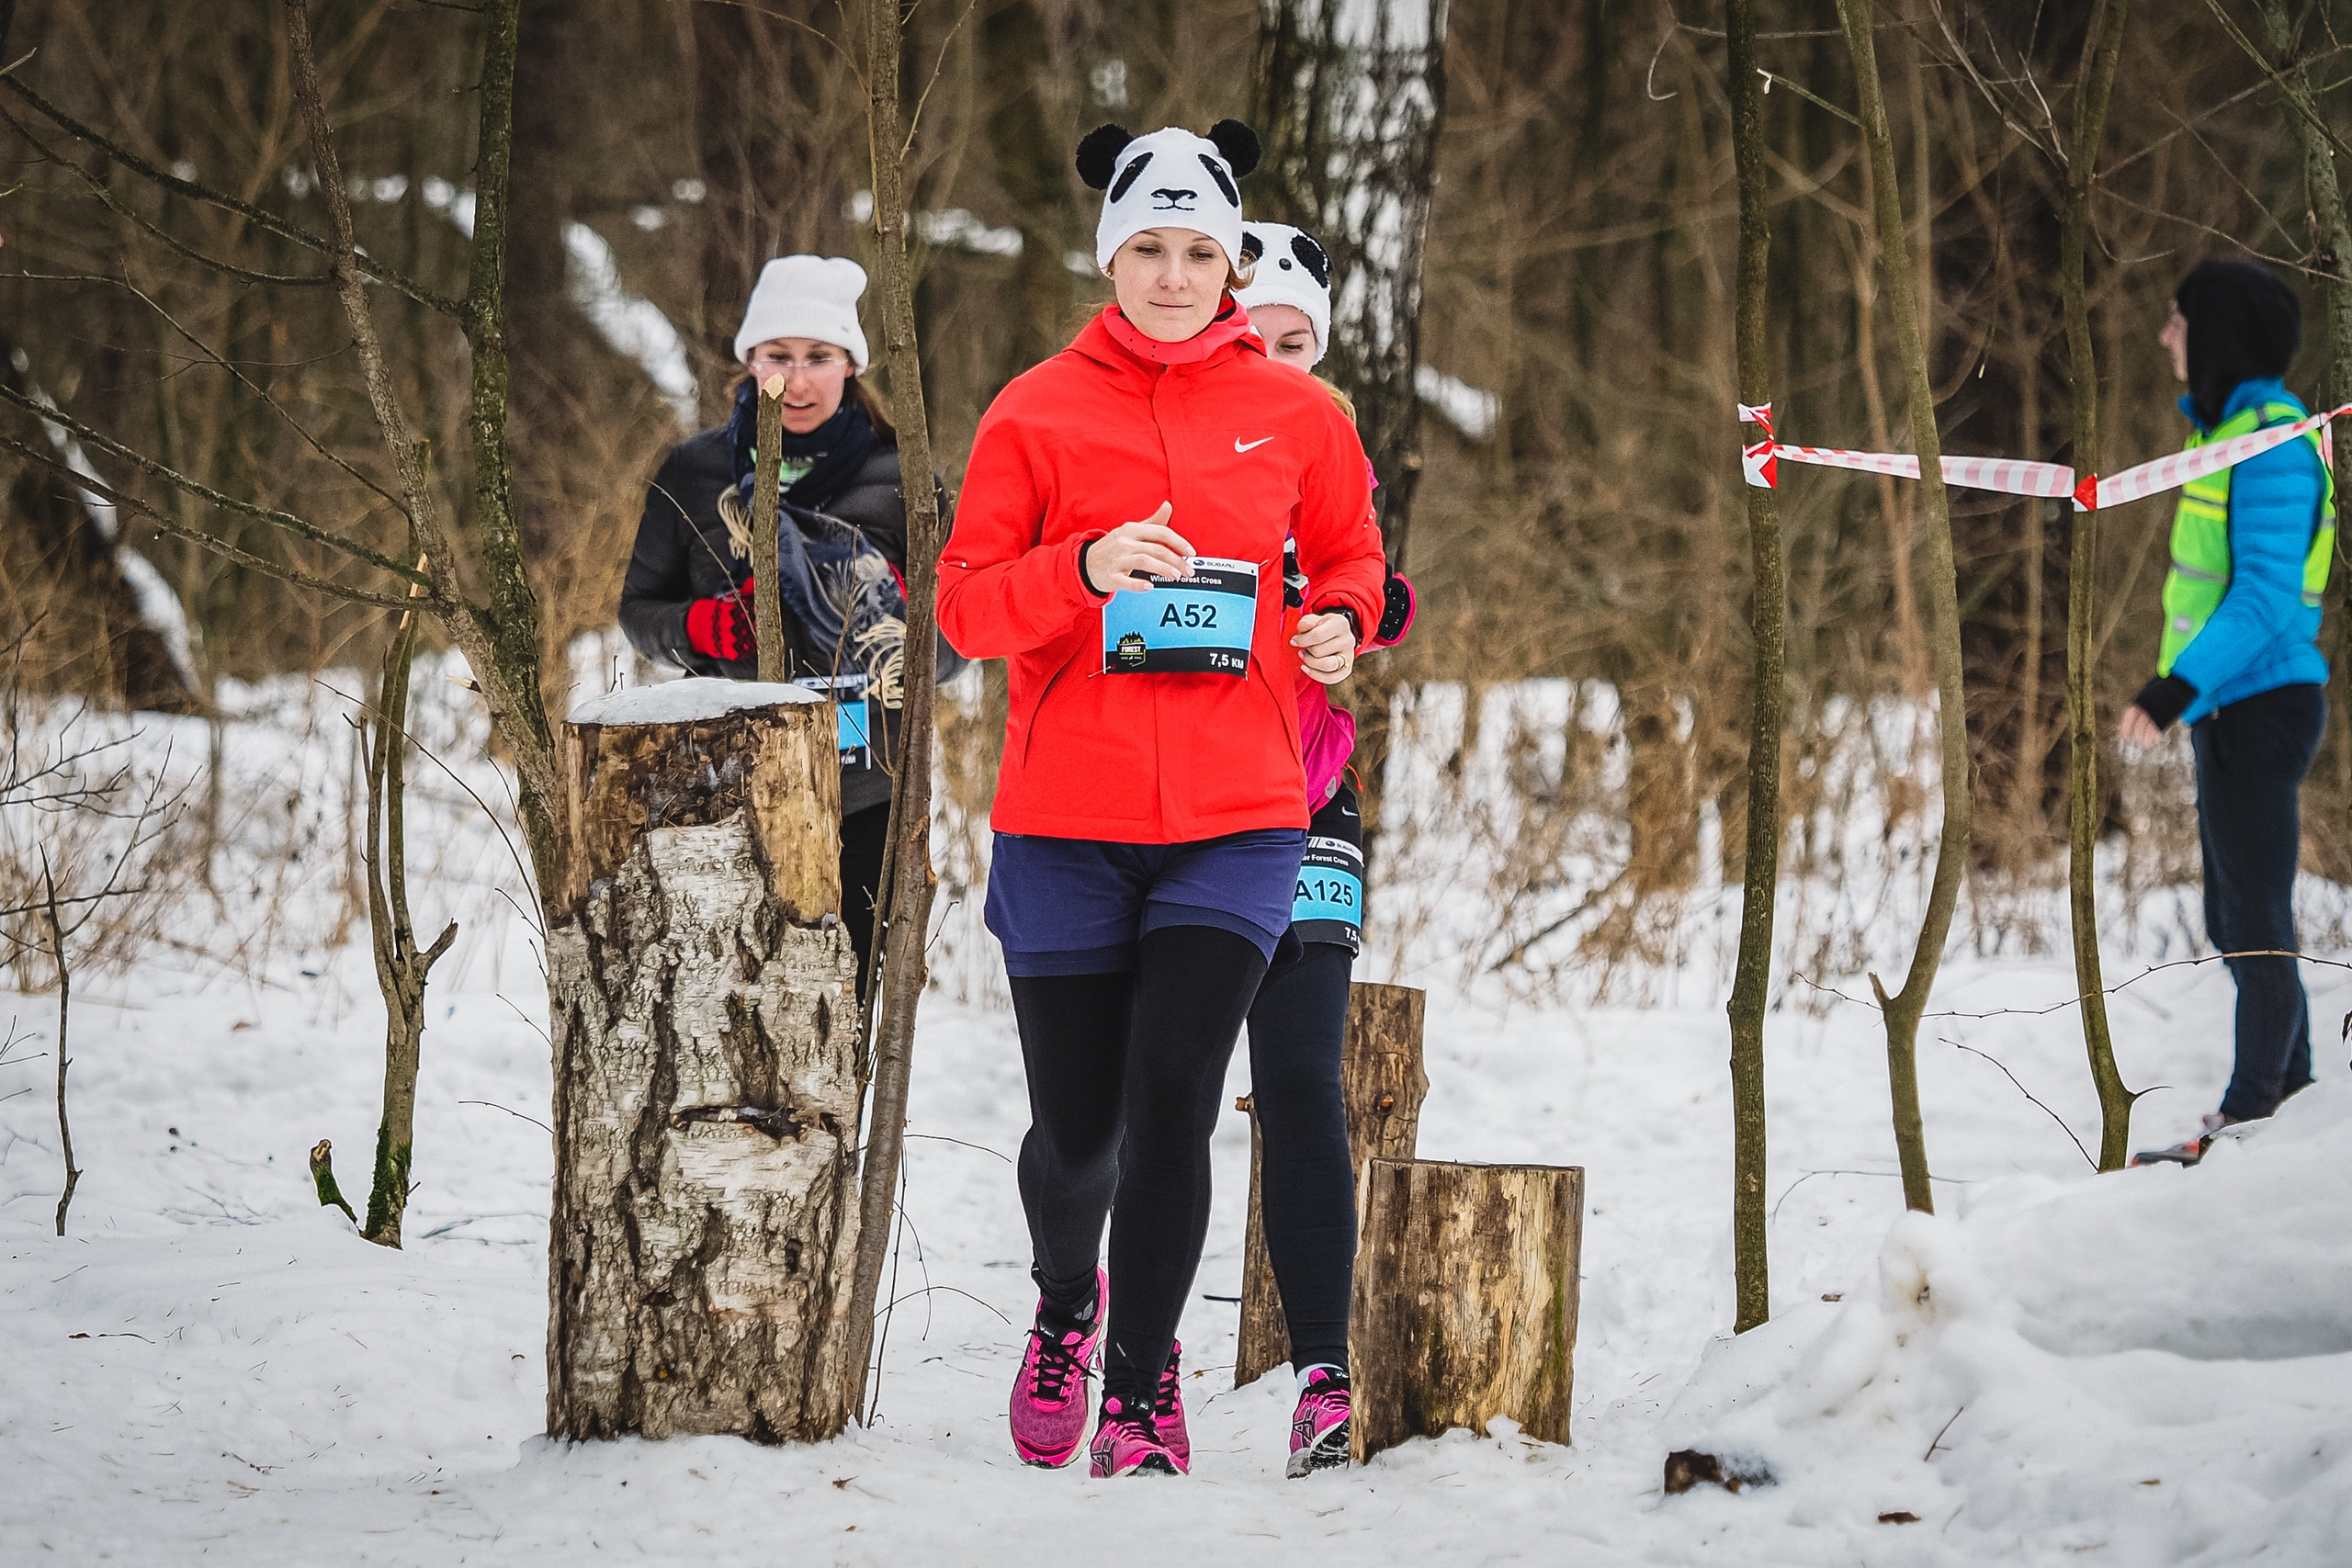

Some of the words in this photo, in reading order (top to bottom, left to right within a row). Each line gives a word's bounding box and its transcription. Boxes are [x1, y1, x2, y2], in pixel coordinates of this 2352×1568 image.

[1159, 603, 1217, 629] A52
[1209, 652, 1229, 668] 7,5
[1232, 658, 1244, 669] KM
[1311, 854, 1332, 863] Forest
[1294, 879, 1353, 907] A125
